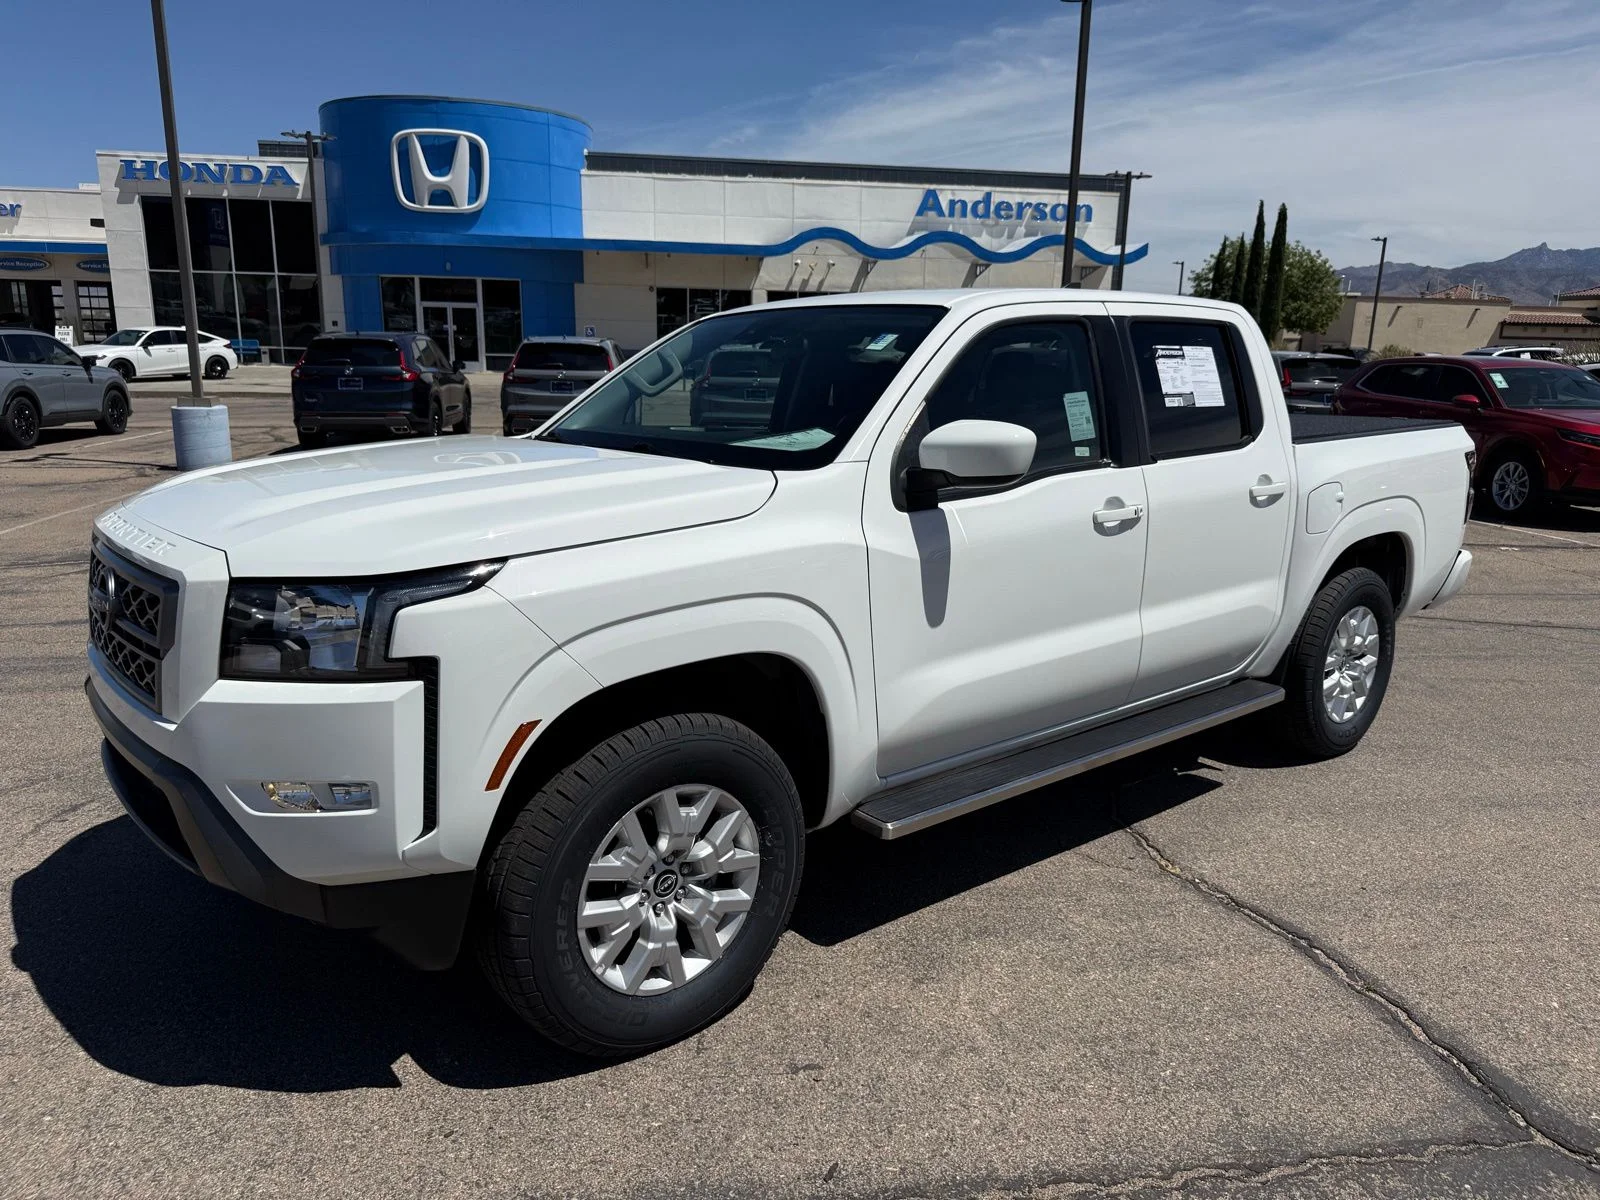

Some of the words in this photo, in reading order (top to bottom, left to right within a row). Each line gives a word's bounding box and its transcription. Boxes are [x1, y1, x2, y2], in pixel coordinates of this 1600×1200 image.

[119, 159, 300, 186] HONDA
[915, 189, 1093, 223] Anderson
[100, 511, 176, 556] FRONTIER
